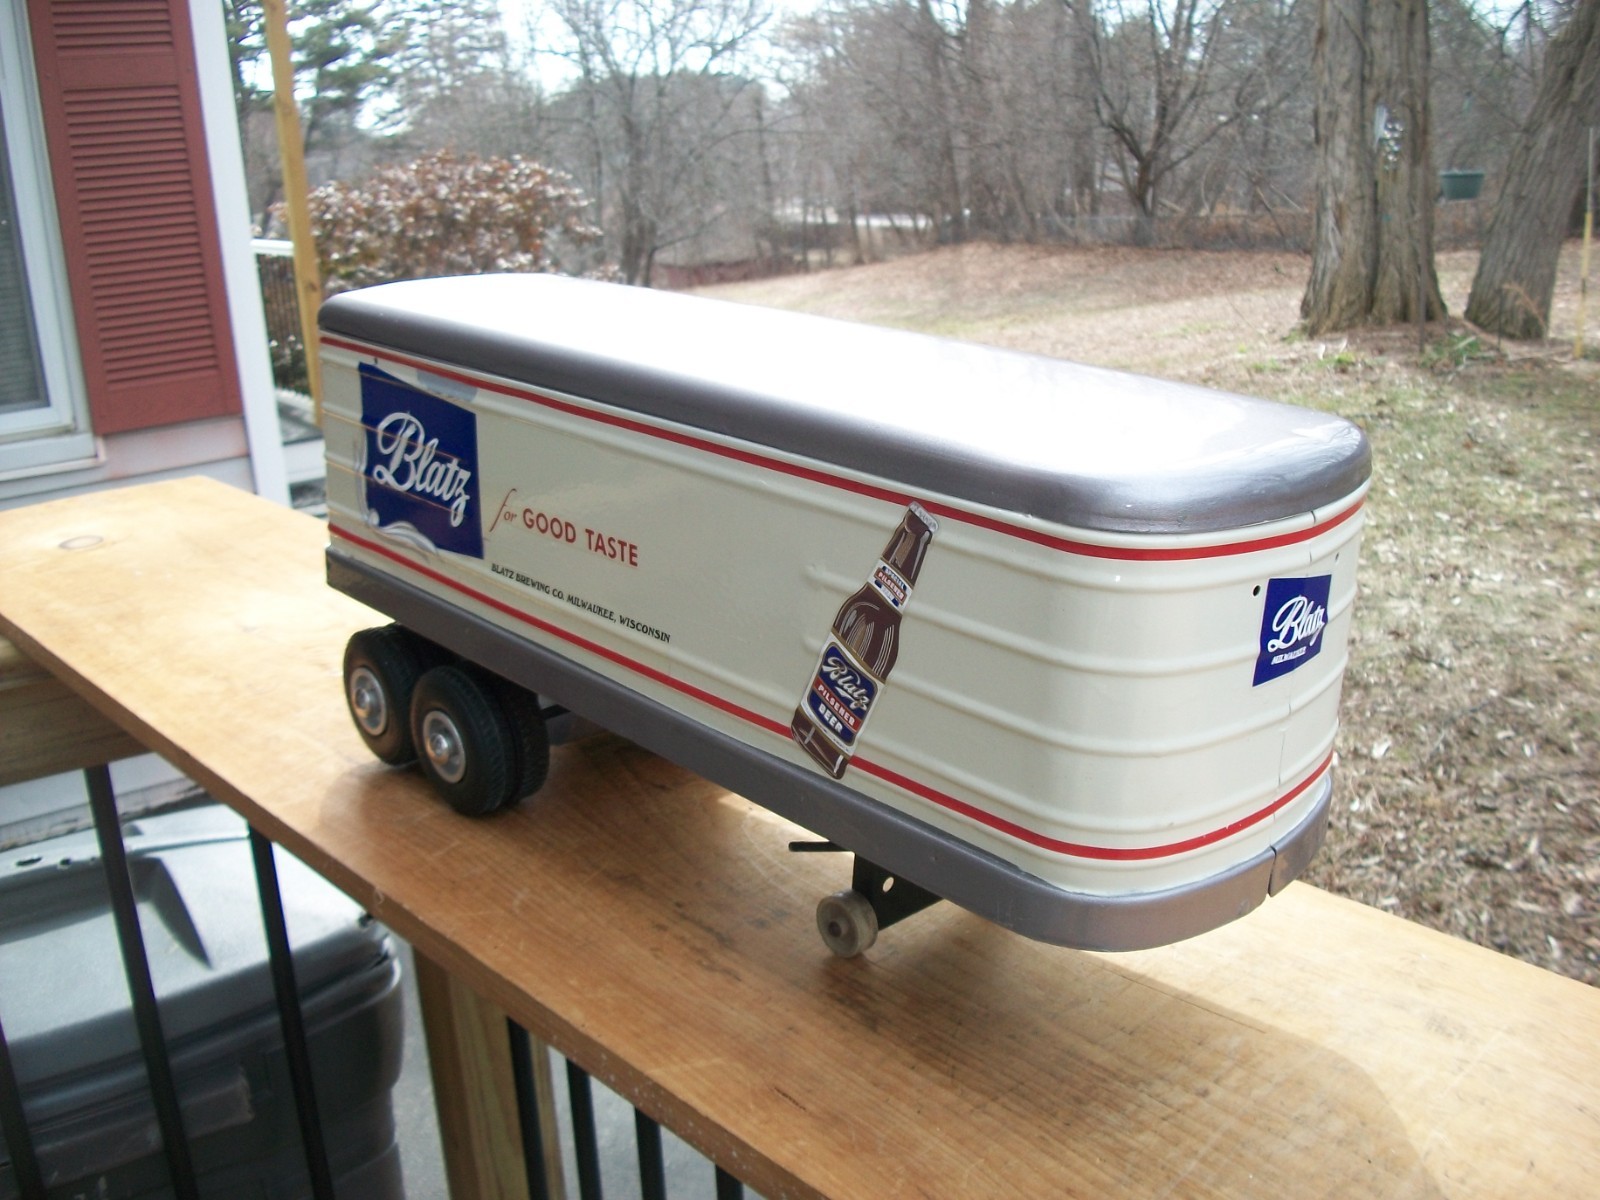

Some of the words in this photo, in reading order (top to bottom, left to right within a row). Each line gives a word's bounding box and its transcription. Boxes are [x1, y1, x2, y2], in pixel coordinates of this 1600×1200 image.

[373, 411, 471, 527] Blatz
[489, 488, 517, 532] for
[523, 508, 576, 543] GOOD
[585, 528, 638, 567] TASTE
[491, 563, 514, 580] BLATZ
[516, 573, 550, 594] BREWING
[552, 588, 565, 601] CO.
[567, 594, 617, 623] MILWAUKEE,
[619, 615, 671, 643] WISCONSIN
[1267, 595, 1326, 653] Blatz
[817, 684, 856, 727] PILSENER
[821, 656, 870, 711] Blatz
[818, 703, 844, 733] BEER
